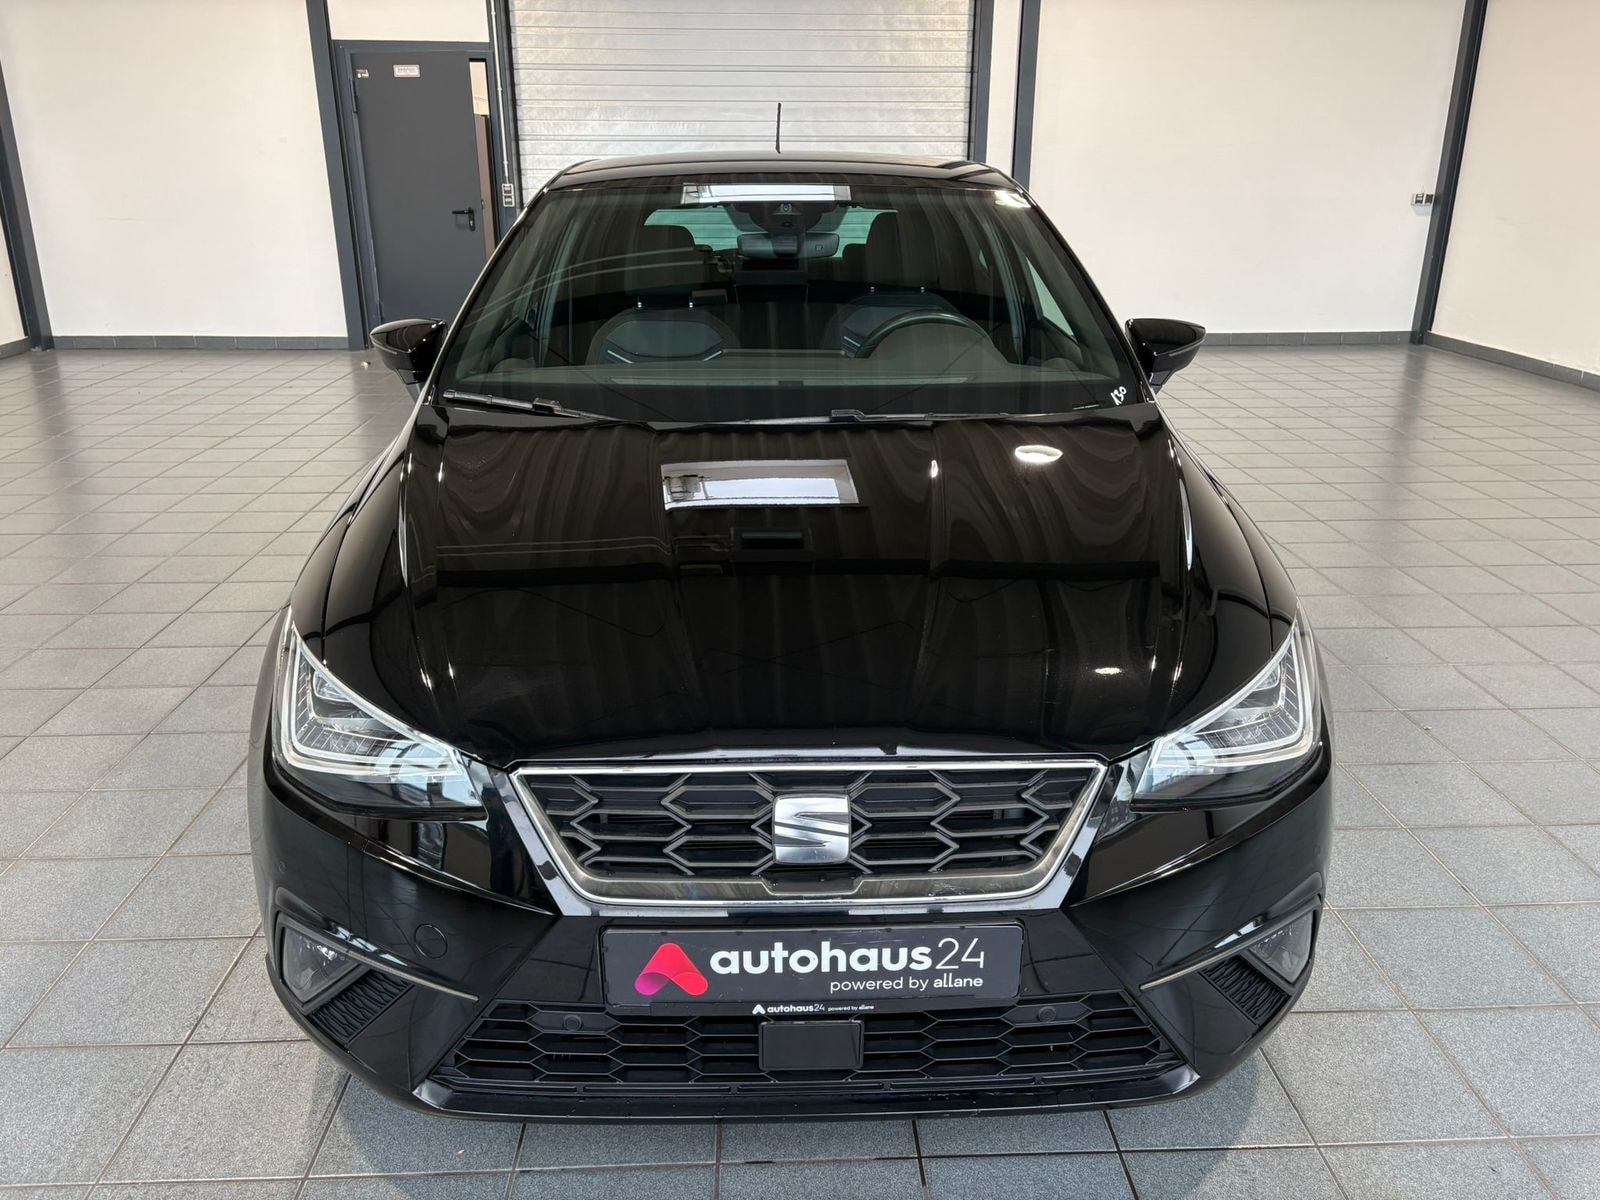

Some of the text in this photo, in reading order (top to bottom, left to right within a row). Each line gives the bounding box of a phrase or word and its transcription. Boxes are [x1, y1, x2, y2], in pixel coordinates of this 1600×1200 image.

[709, 937, 985, 975] autohaus24
[829, 973, 984, 994] powered by allane
[766, 1003, 826, 1014] autohaus24
